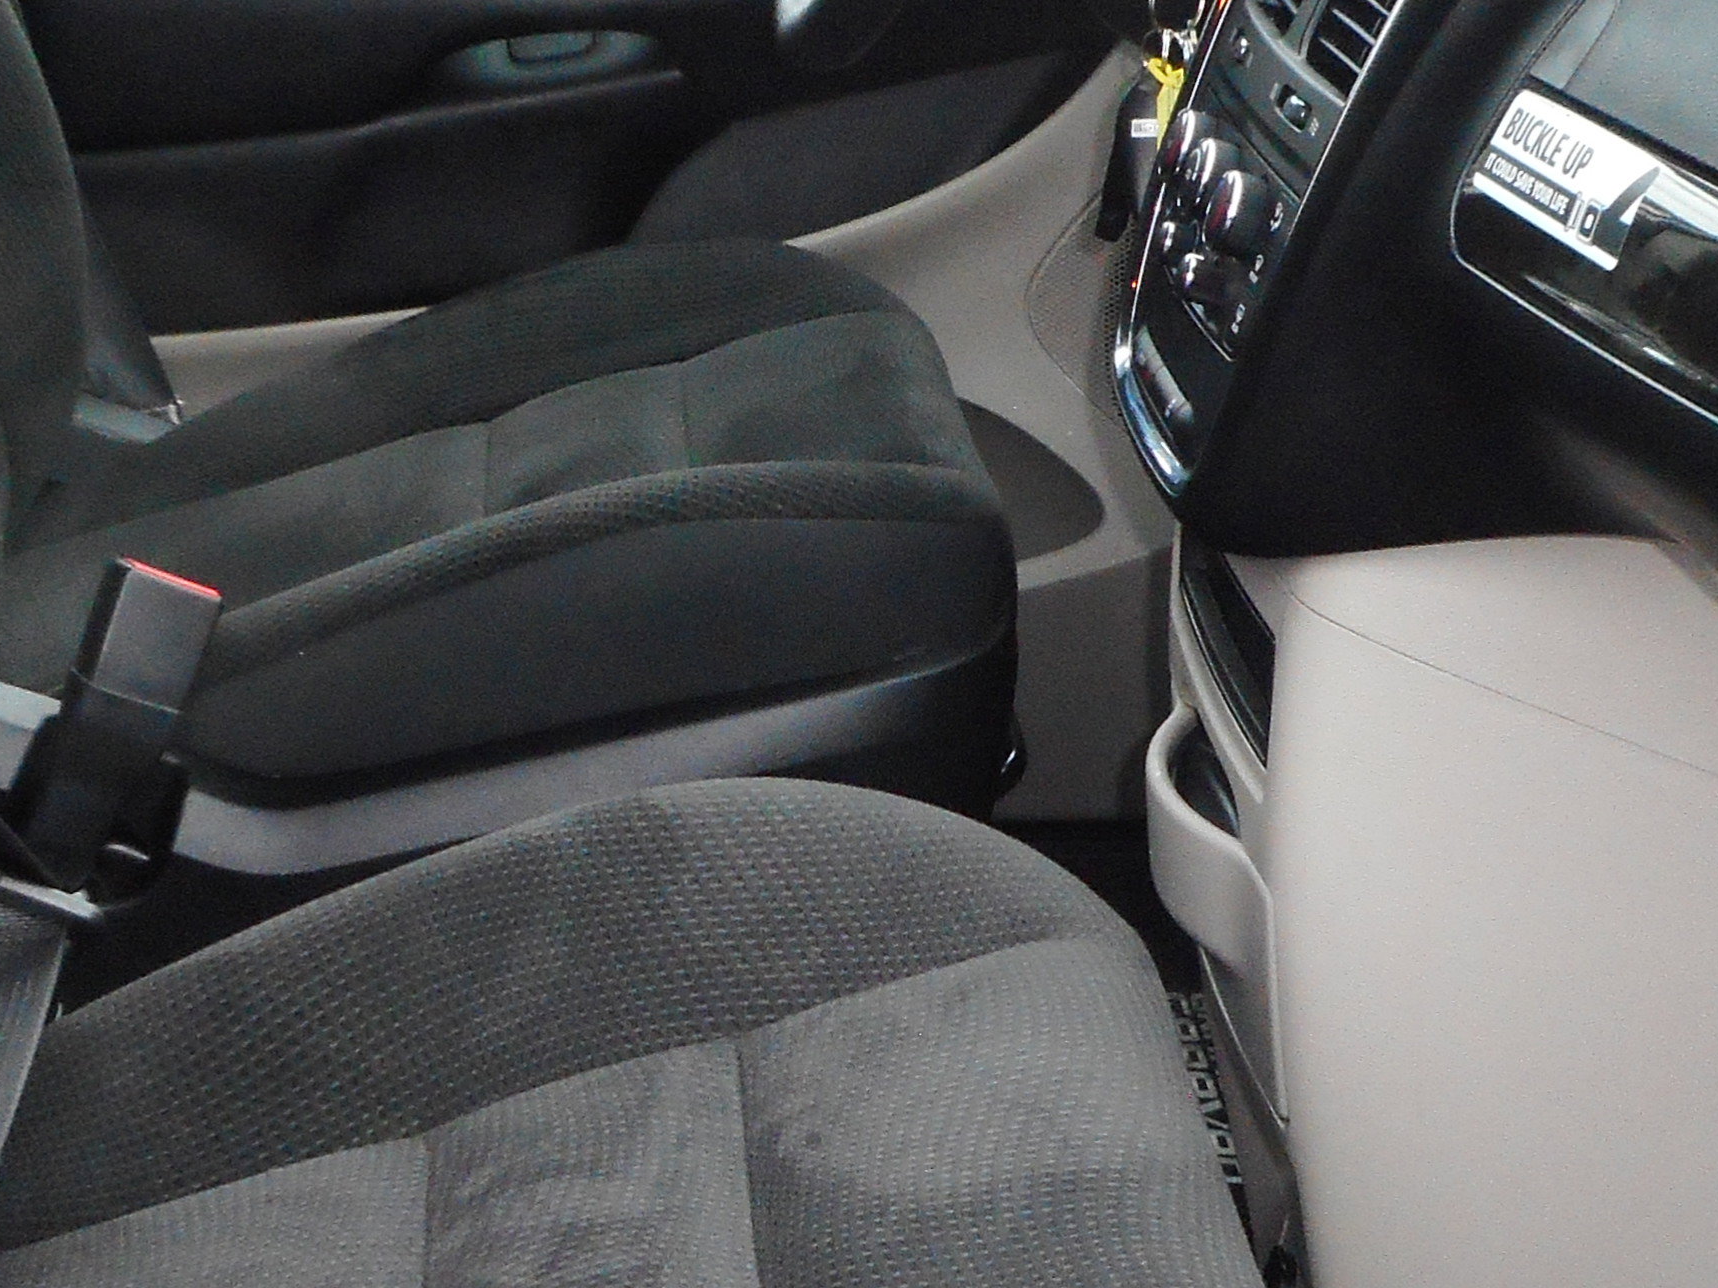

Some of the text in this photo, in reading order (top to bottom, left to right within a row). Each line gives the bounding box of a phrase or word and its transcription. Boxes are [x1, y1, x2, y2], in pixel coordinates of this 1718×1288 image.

[1501, 108, 1595, 179] BUCKLE UP
[1484, 152, 1570, 215] IT COULD SAVE YOUR LIFE
